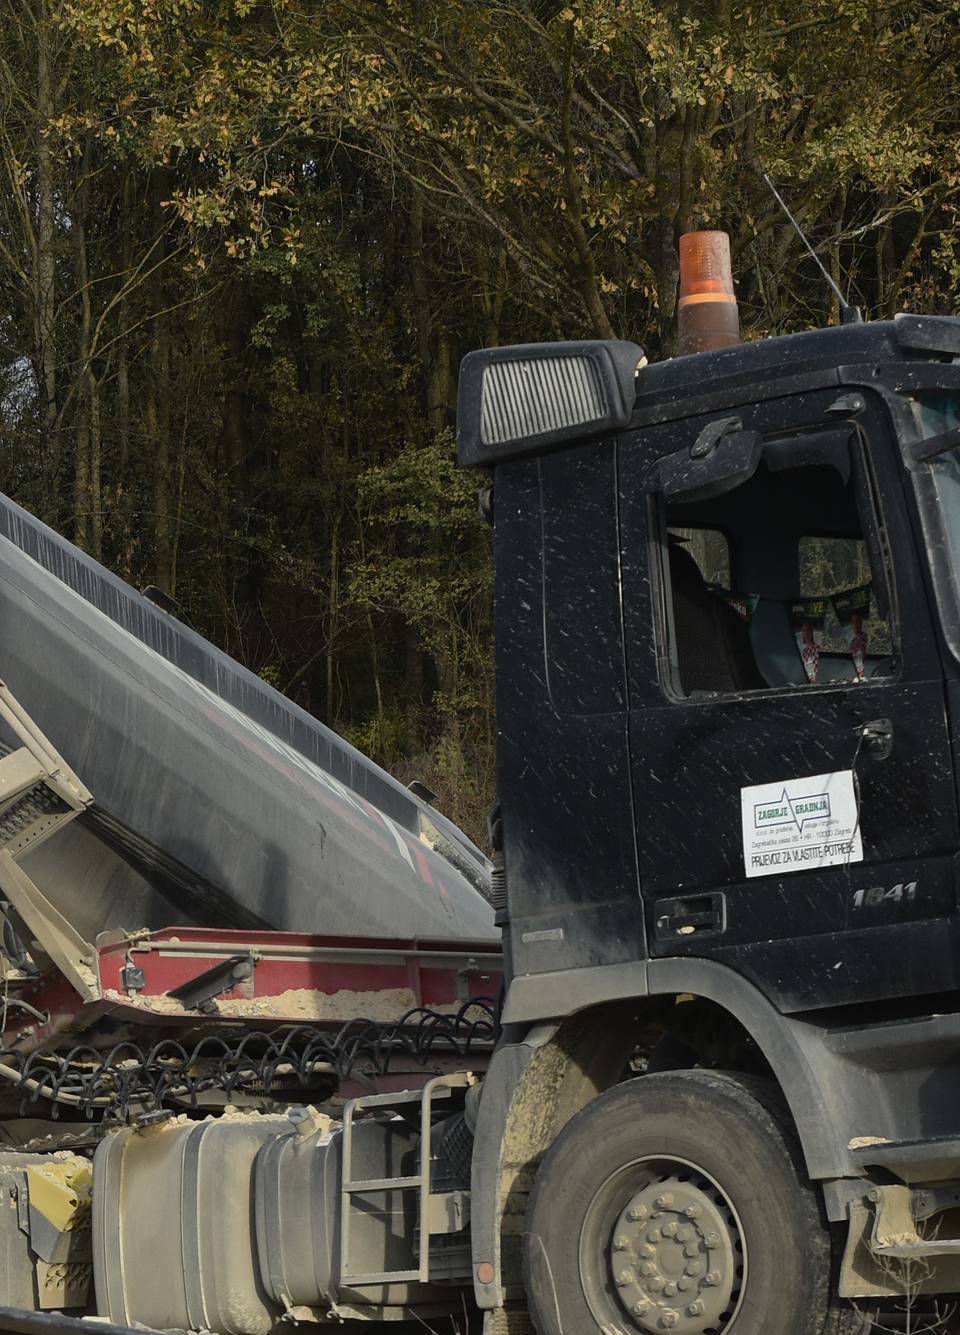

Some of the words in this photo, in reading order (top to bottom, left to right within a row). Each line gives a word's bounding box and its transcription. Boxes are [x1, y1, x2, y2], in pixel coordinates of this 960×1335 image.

[758, 806, 788, 821] ZAGORJE
[795, 800, 828, 815] GRADNJA
[751, 850, 781, 868] PRIJEVOZ
[782, 849, 792, 861] ZA
[793, 846, 823, 862] VLASTITE
[852, 881, 918, 907] 1841
